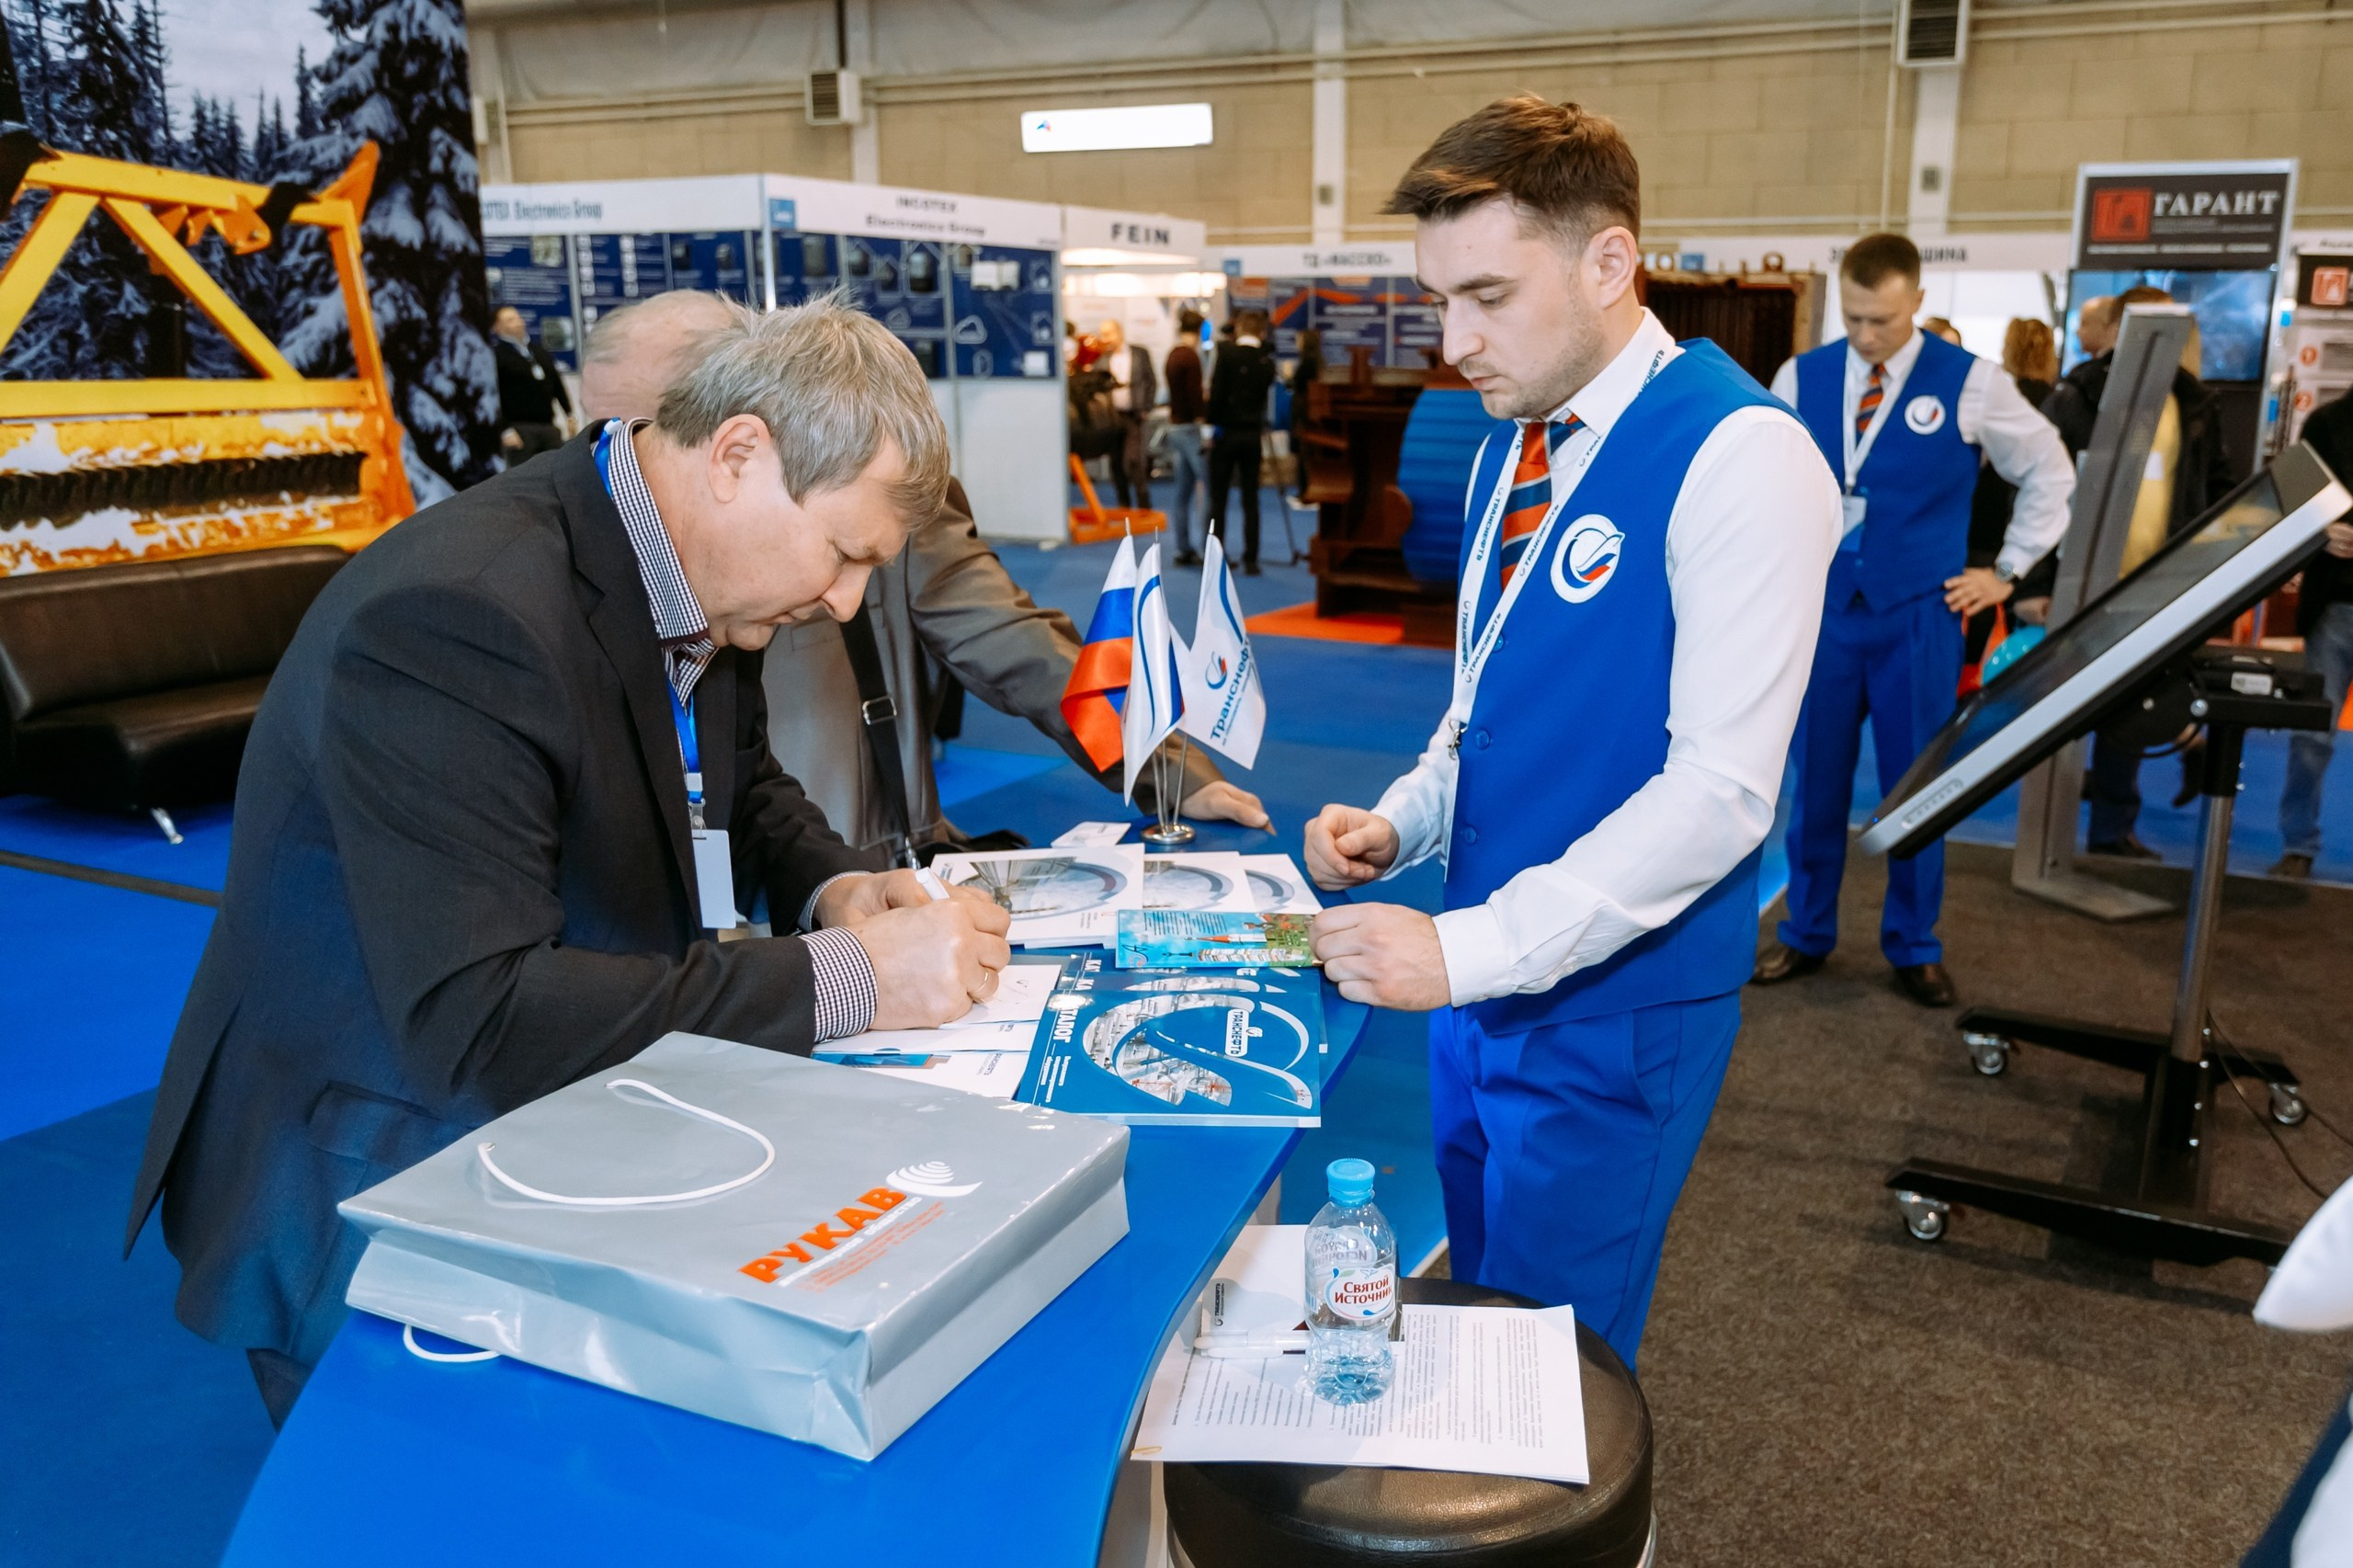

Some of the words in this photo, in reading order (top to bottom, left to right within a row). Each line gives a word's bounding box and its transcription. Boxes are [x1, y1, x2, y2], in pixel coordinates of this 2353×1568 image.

[2154, 190, 2279, 216] ГАРАНТ
[1111, 222, 1171, 245] FEIN
[1476, 497, 1500, 562] ТРАНСНЕФТЬ
[1524, 505, 1559, 566] ТРАНСНЕФТЬ
[1470, 613, 1501, 673] ТРАНСНЕФТЬ
[1210, 641, 1250, 739] Транснеф
[1231, 1011, 1244, 1054] ТРАНСНЕФТЬ
[737, 1186, 907, 1283] РУКАВ
[1344, 1275, 1389, 1293] Святой
